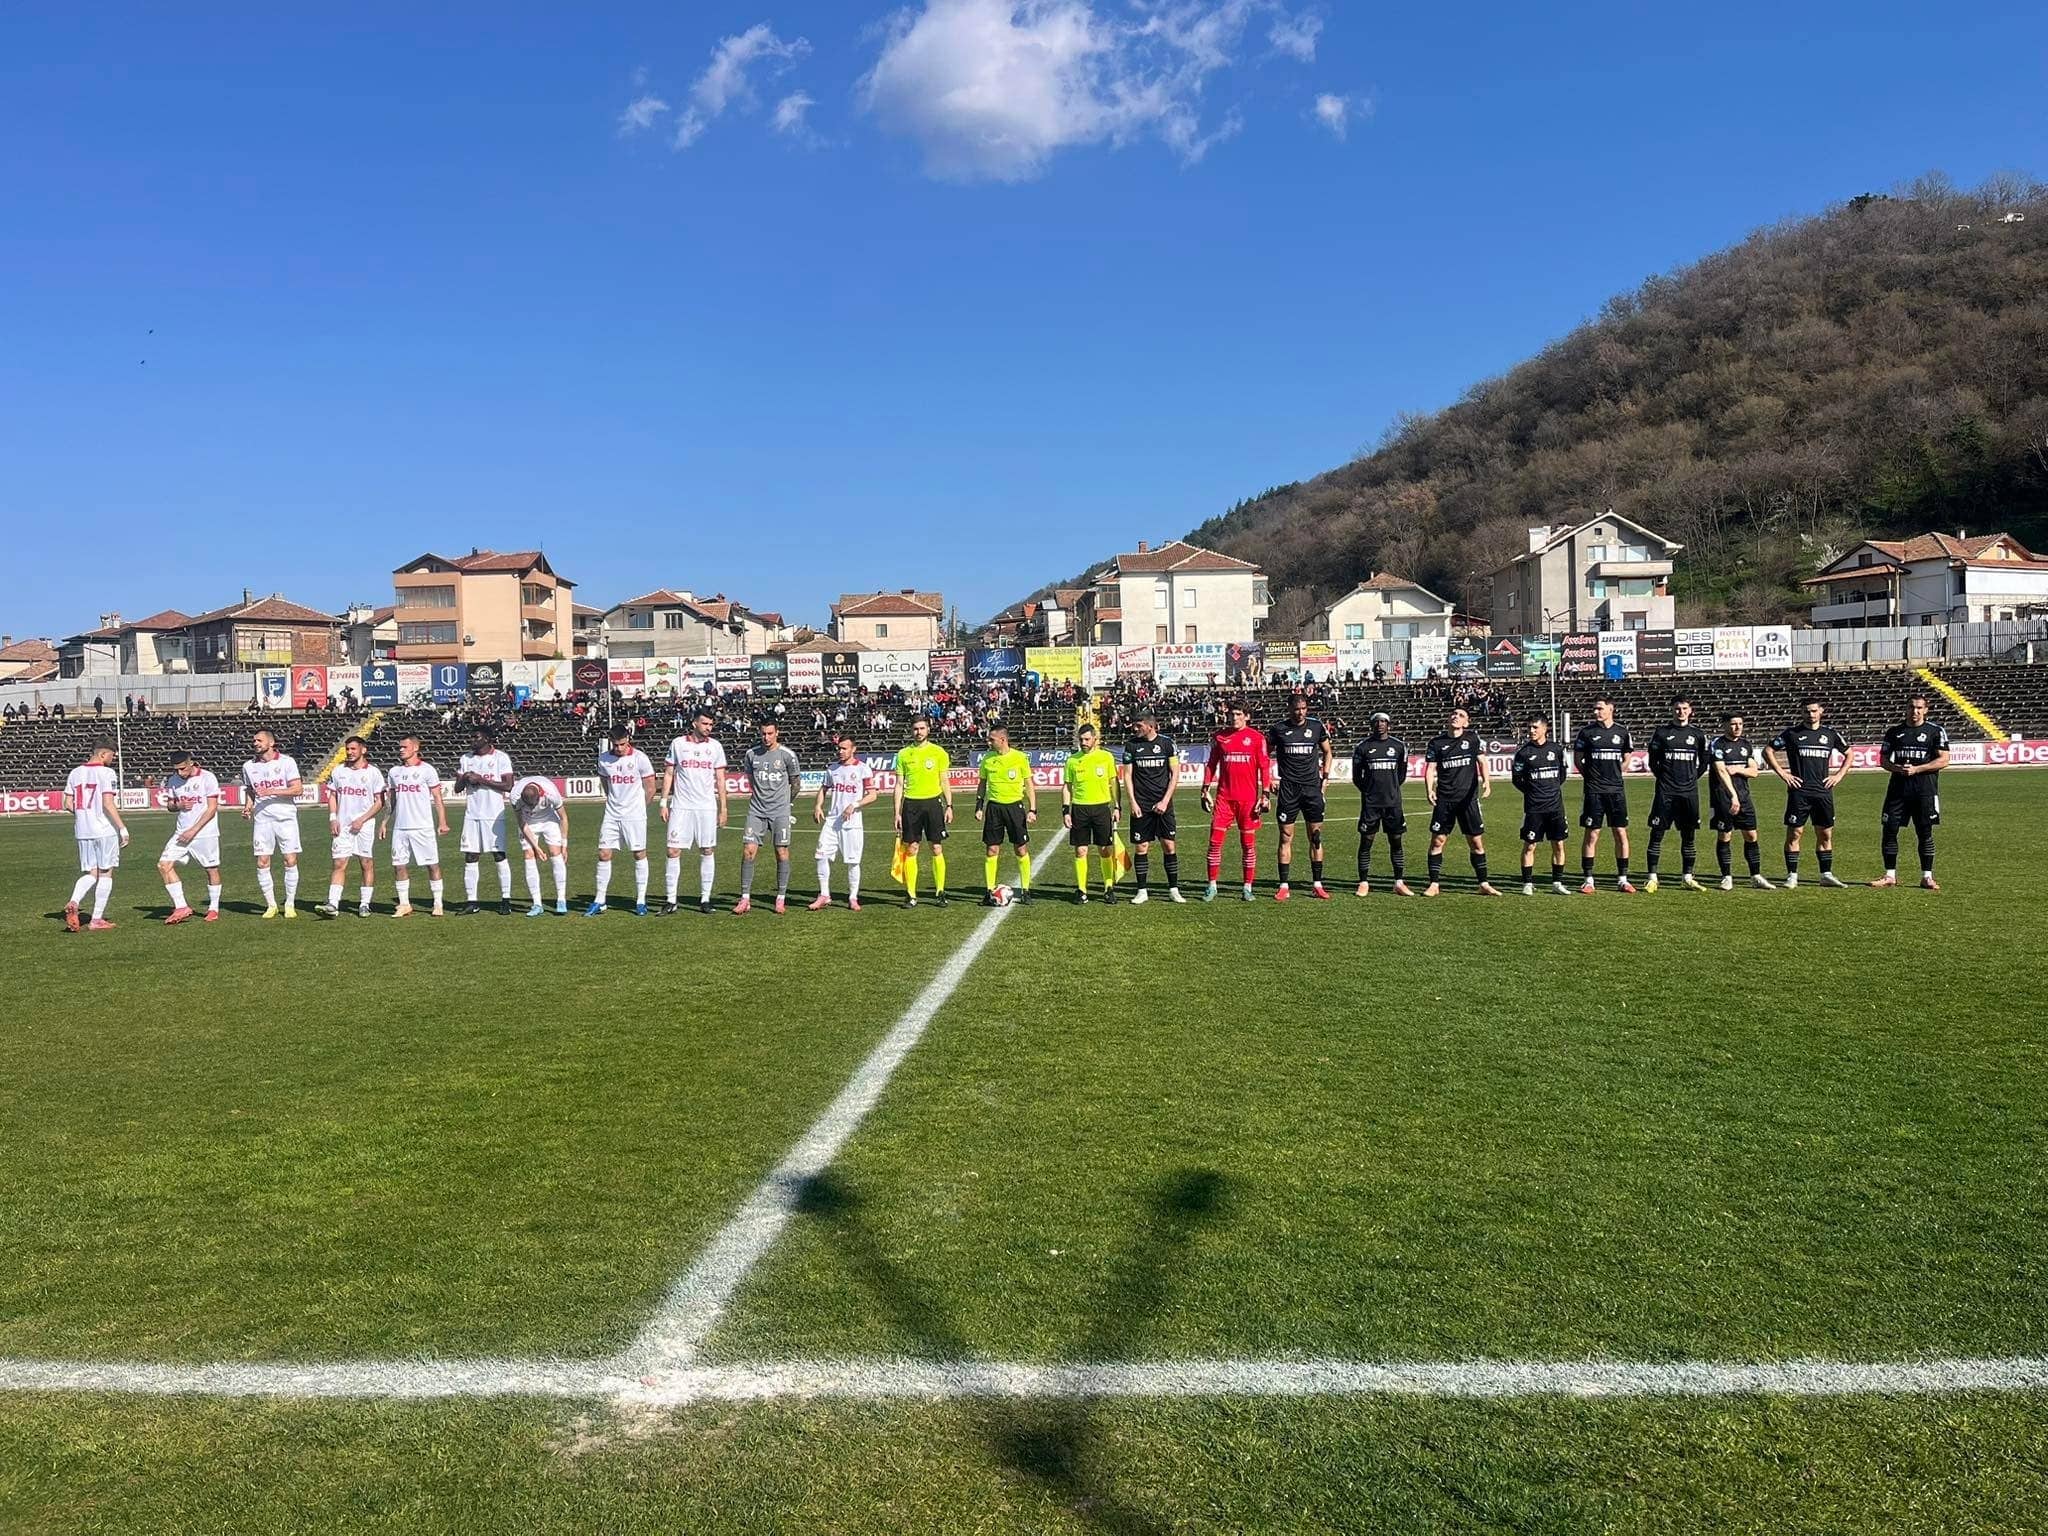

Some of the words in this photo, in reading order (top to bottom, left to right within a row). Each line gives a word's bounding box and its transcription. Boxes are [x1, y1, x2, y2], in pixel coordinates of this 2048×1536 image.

[1677, 632, 1712, 641] DIES
[1155, 645, 1223, 655] ТАХОНЕТ
[1677, 645, 1712, 655] DIES
[862, 663, 926, 673] OGICOM
[1677, 658, 1713, 668] DIES
[433, 688, 466, 696] ETICOM
[1988, 744, 2048, 762] efbe
[680, 759, 713, 769] efbet
[1135, 759, 1165, 768] WINBET
[757, 770, 783, 782] fbet
[338, 786, 367, 797] efbet
[568, 779, 593, 794] 100
[74, 783, 98, 810] 17
